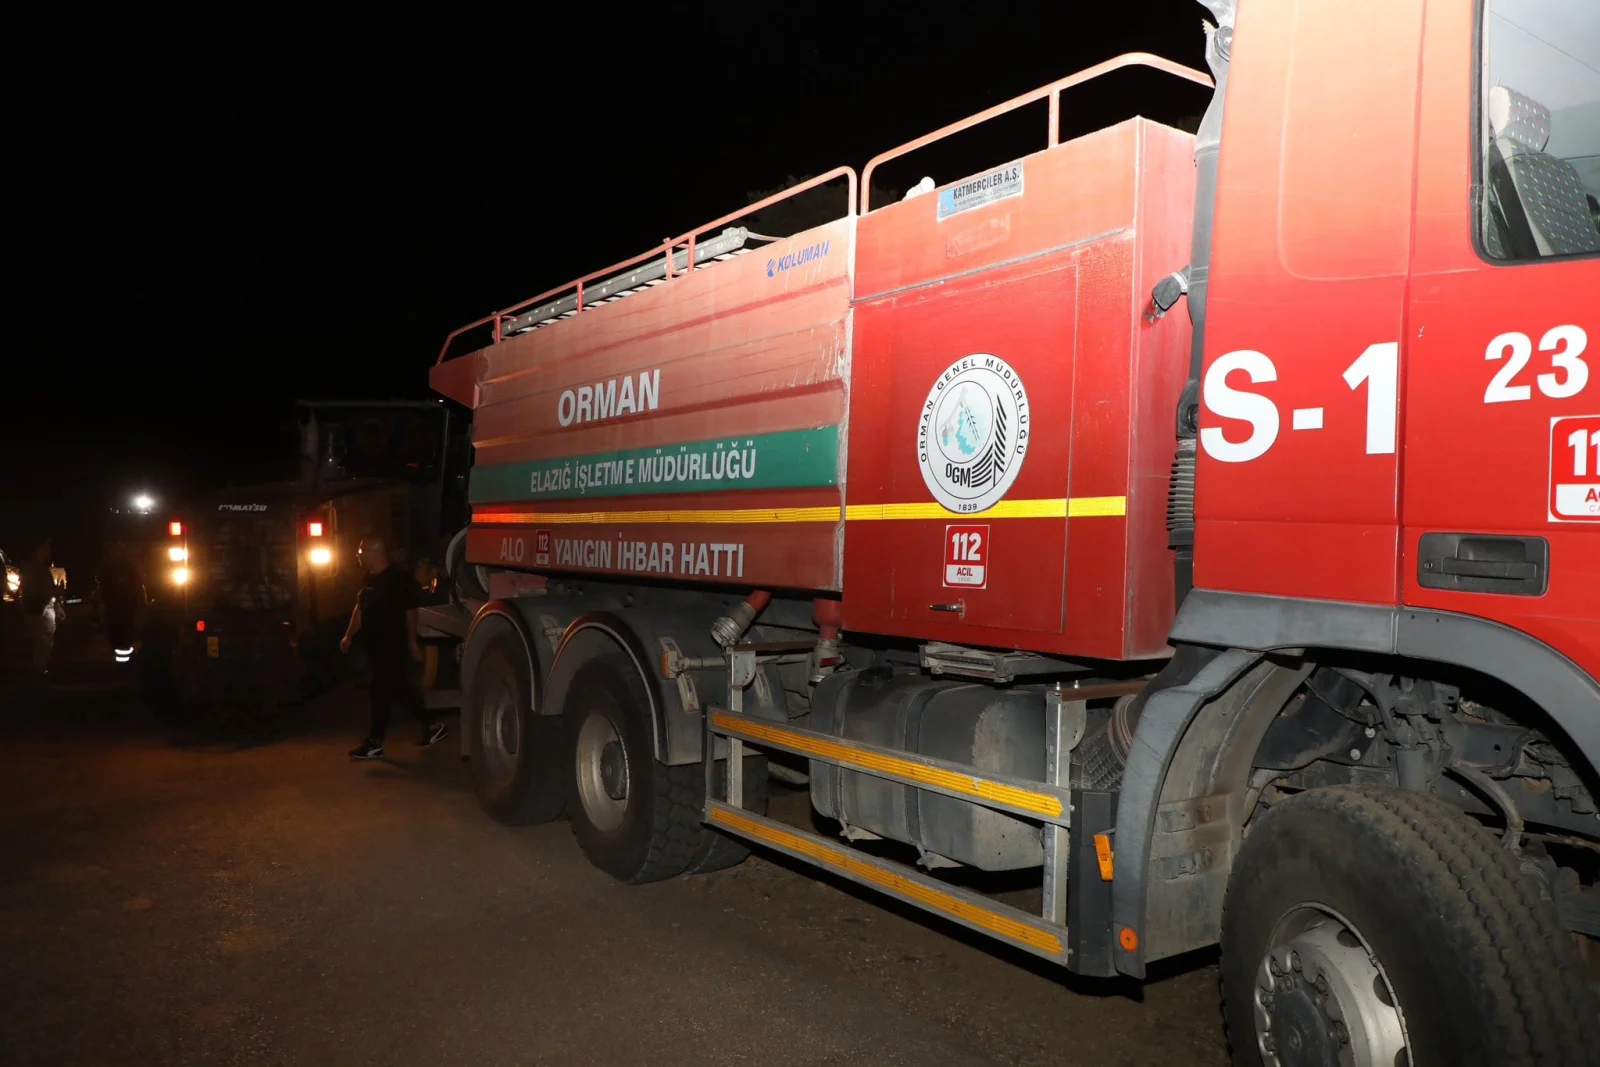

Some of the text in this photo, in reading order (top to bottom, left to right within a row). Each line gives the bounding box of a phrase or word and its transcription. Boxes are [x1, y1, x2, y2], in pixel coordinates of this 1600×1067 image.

[778, 240, 829, 272] KOLUMAN
[1484, 324, 1589, 403] 23
[557, 368, 660, 427] ORMAN
[920, 358, 1029, 462] ORMAN GENEL MÜDÜRLÜĞÜ
[1200, 341, 1398, 463] S-1
[530, 461, 571, 493] ELAZIĞ
[638, 440, 757, 483] MÜDÜRLÜĞÜ
[945, 463, 971, 488] OGM
[958, 503, 978, 512] 1839
[500, 532, 744, 577] ALO 112 YANGIN İHBAR HATTI
[951, 532, 982, 561] 112
